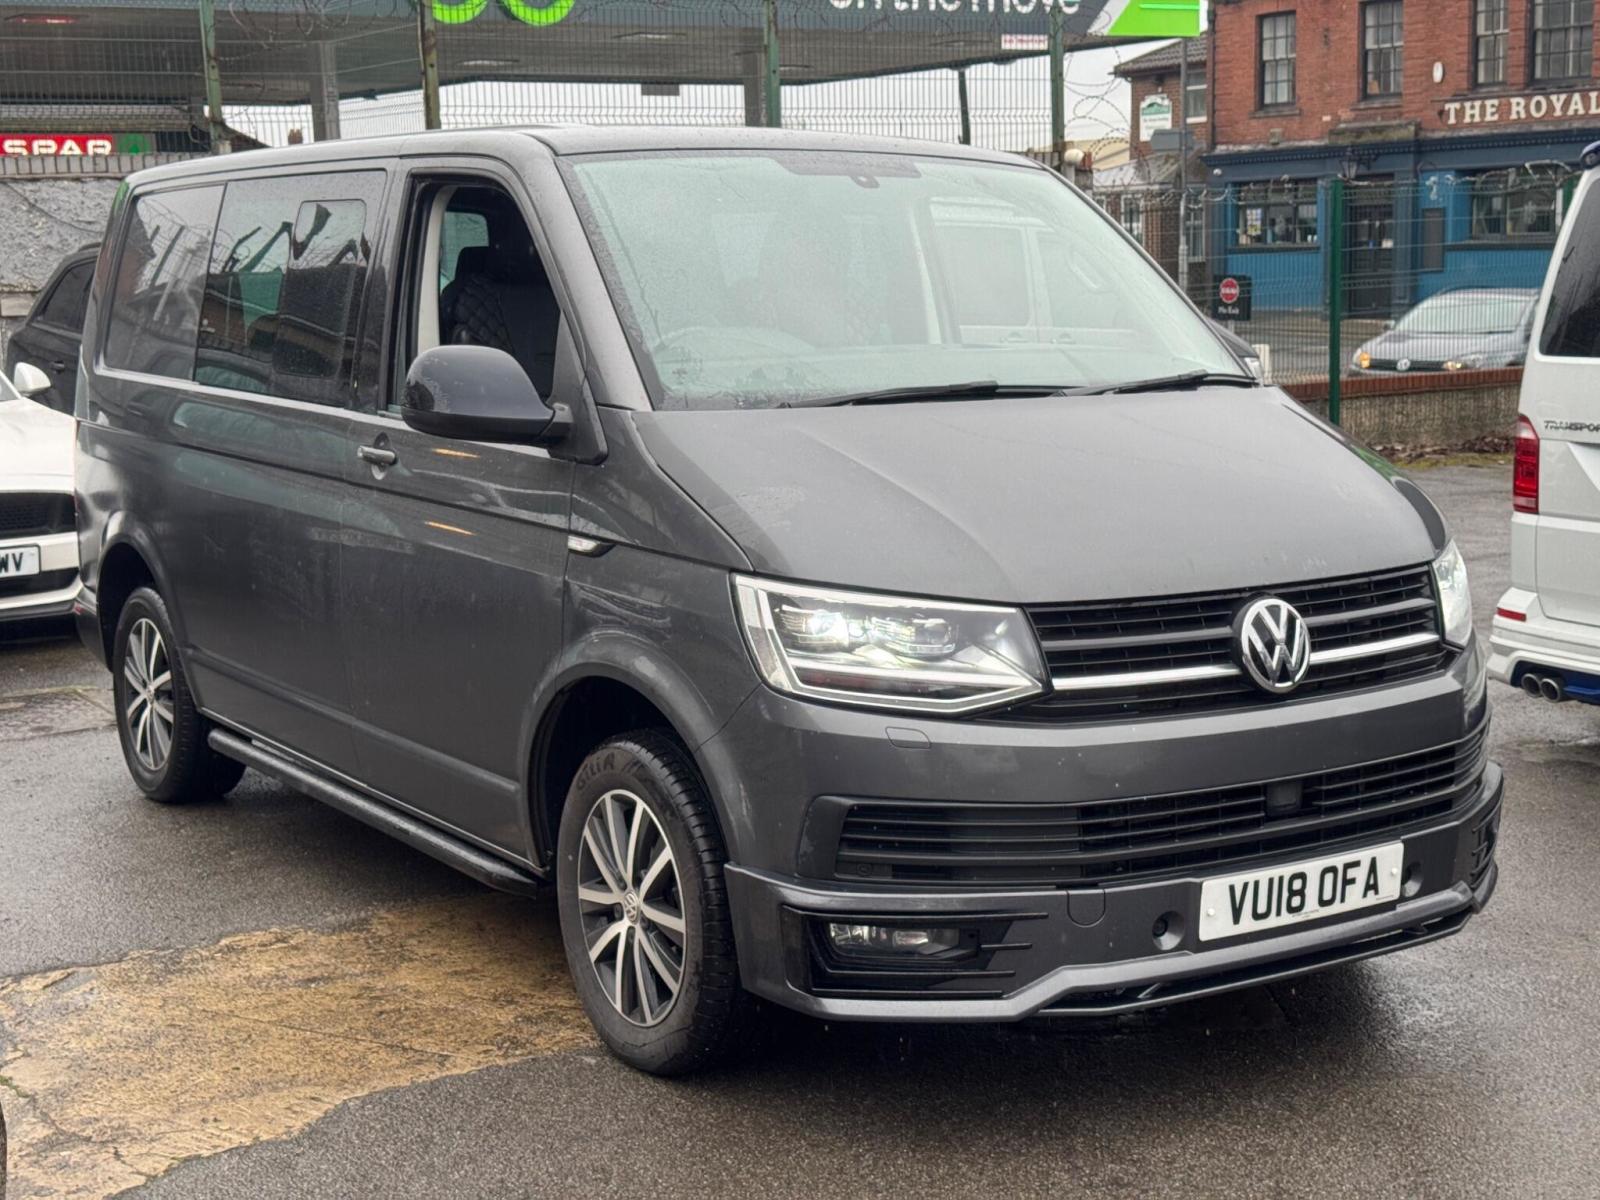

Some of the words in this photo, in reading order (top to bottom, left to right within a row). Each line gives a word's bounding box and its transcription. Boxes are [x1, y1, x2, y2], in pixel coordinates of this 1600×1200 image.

[1444, 100, 1499, 124] THE
[1509, 91, 1600, 119] ROYAL
[3, 139, 112, 155] SPAR
[1229, 871, 1307, 925] VU18
[1318, 857, 1379, 907] OFA
